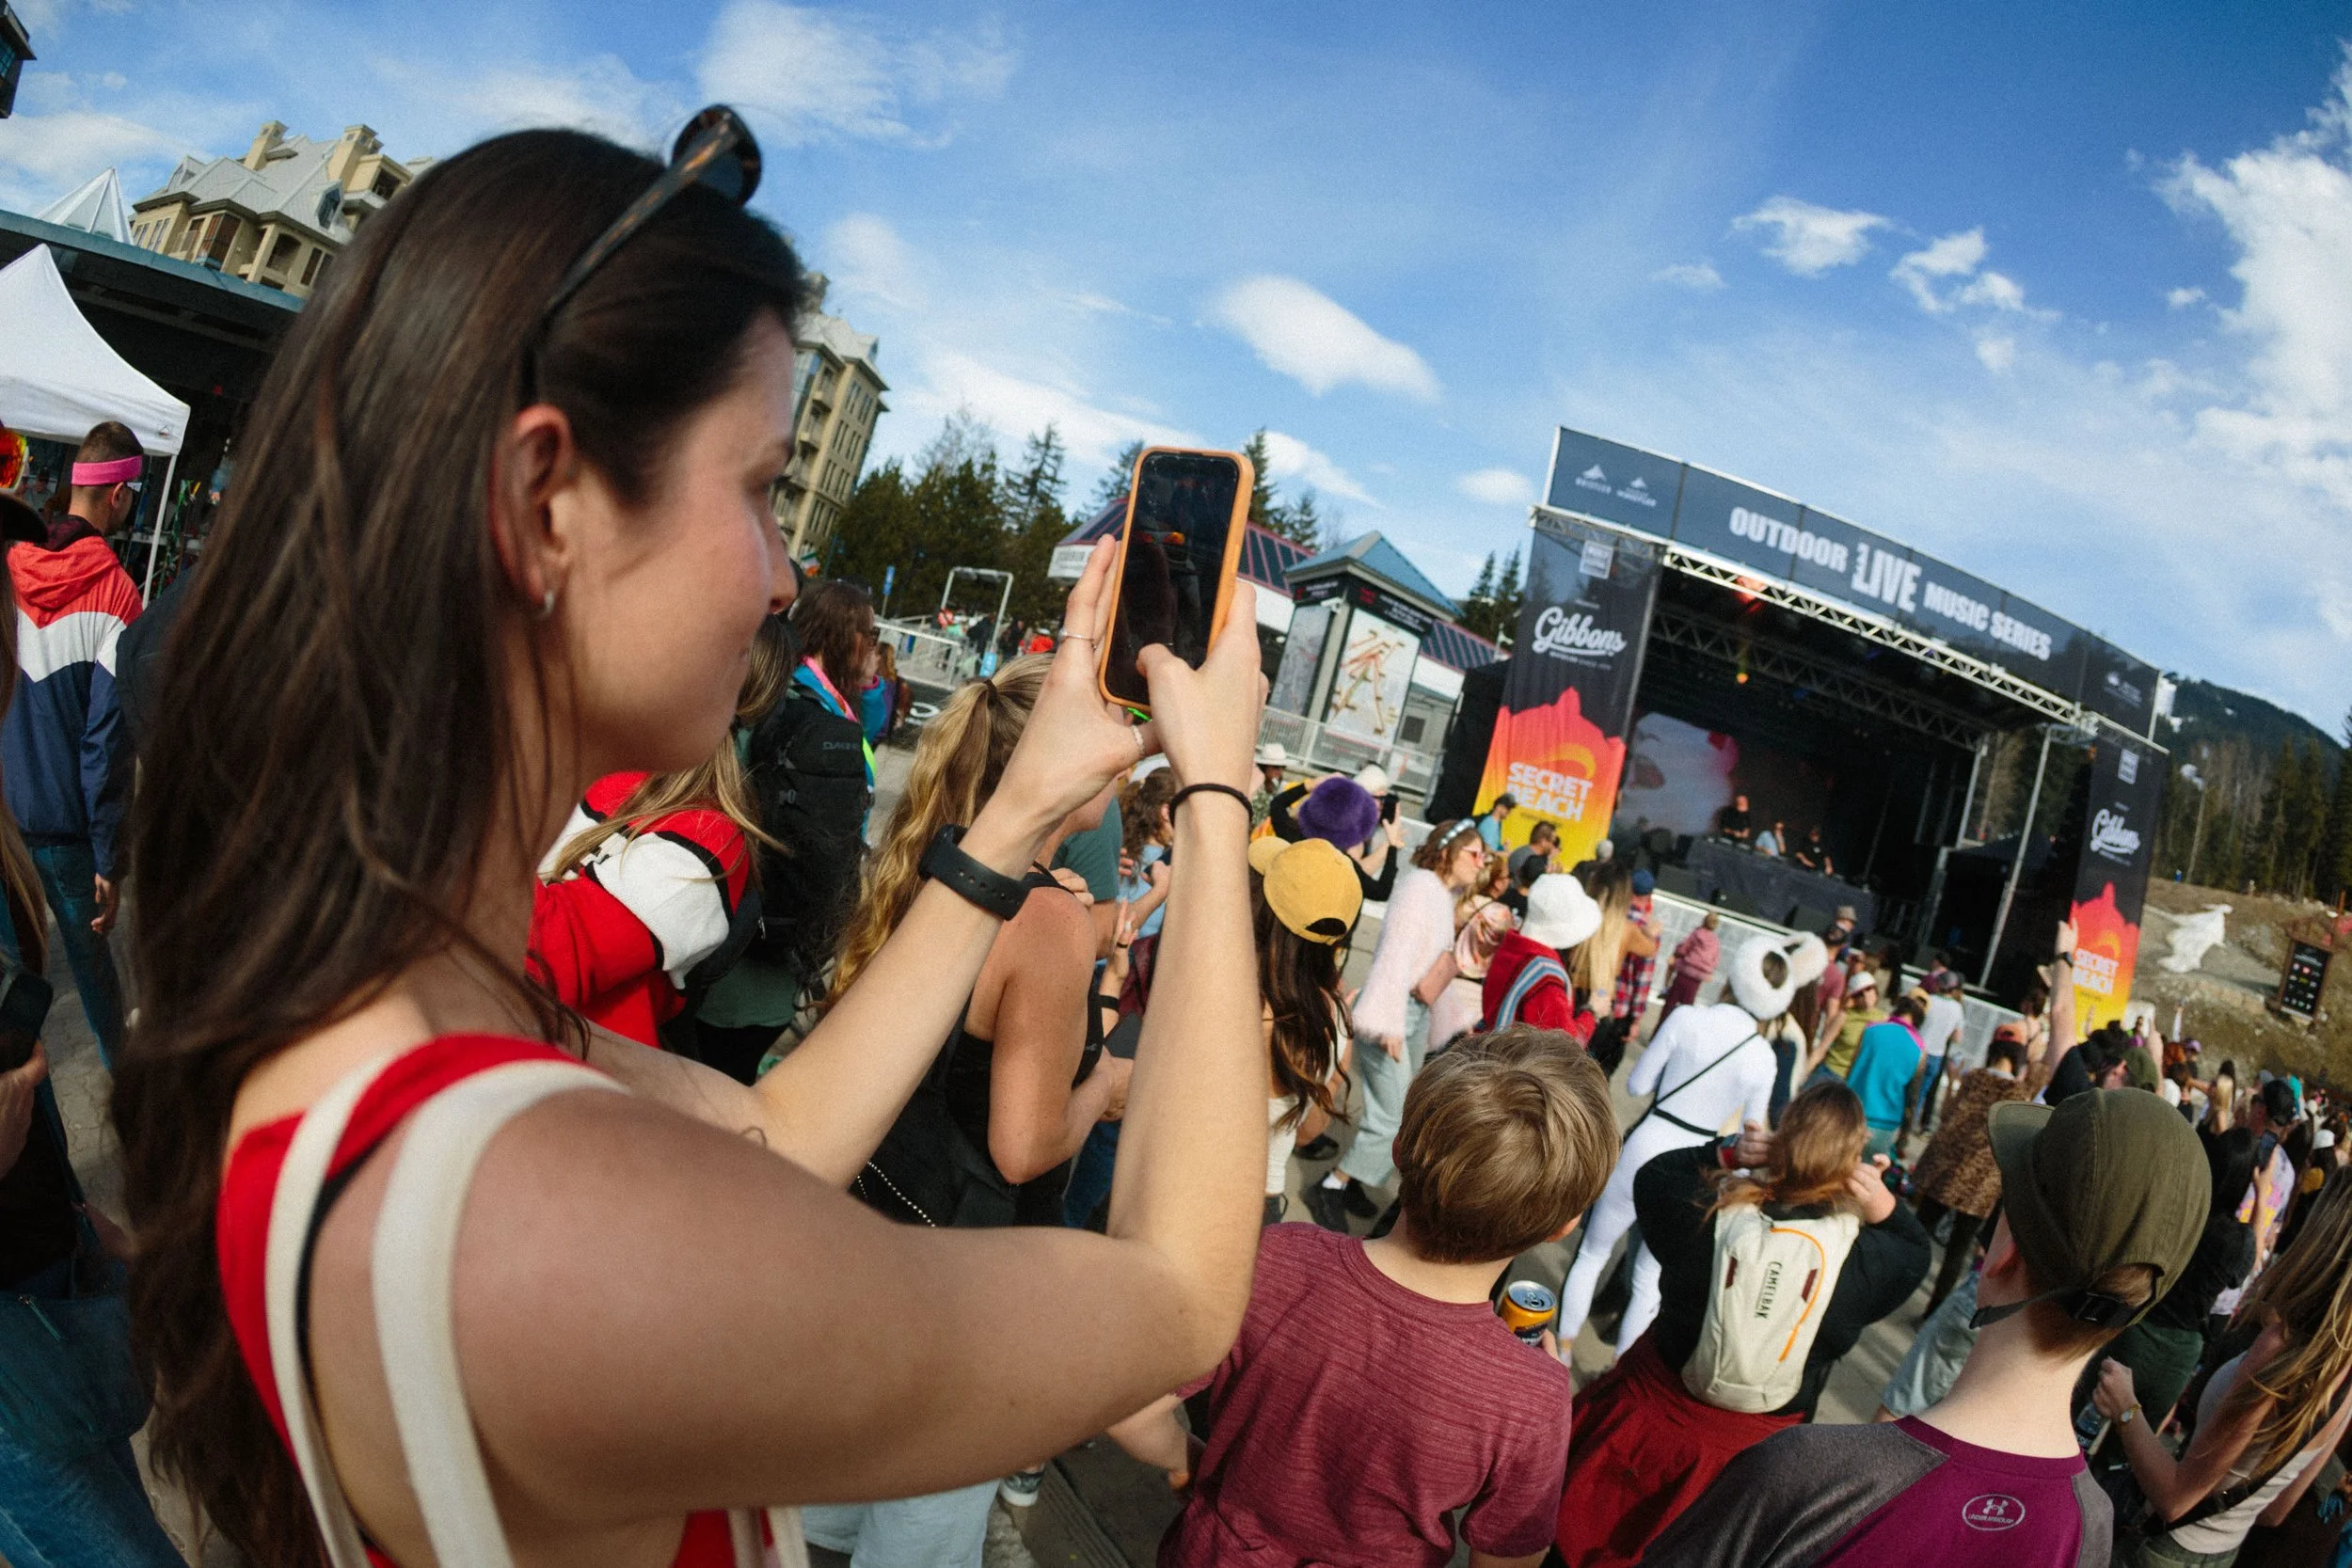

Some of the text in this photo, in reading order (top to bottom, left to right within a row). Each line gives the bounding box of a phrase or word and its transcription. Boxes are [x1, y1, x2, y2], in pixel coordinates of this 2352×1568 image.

[1729, 506, 2053, 661] OUTDOOR LIVE MUSIC SERIES
[1532, 606, 1628, 657] Gibbons
[1507, 761, 1594, 800] SECRET
[2071, 965, 2115, 995] BEACH
[2074, 948, 2120, 977] SECRET
[1754, 1260, 1783, 1319] CAMELBAK
